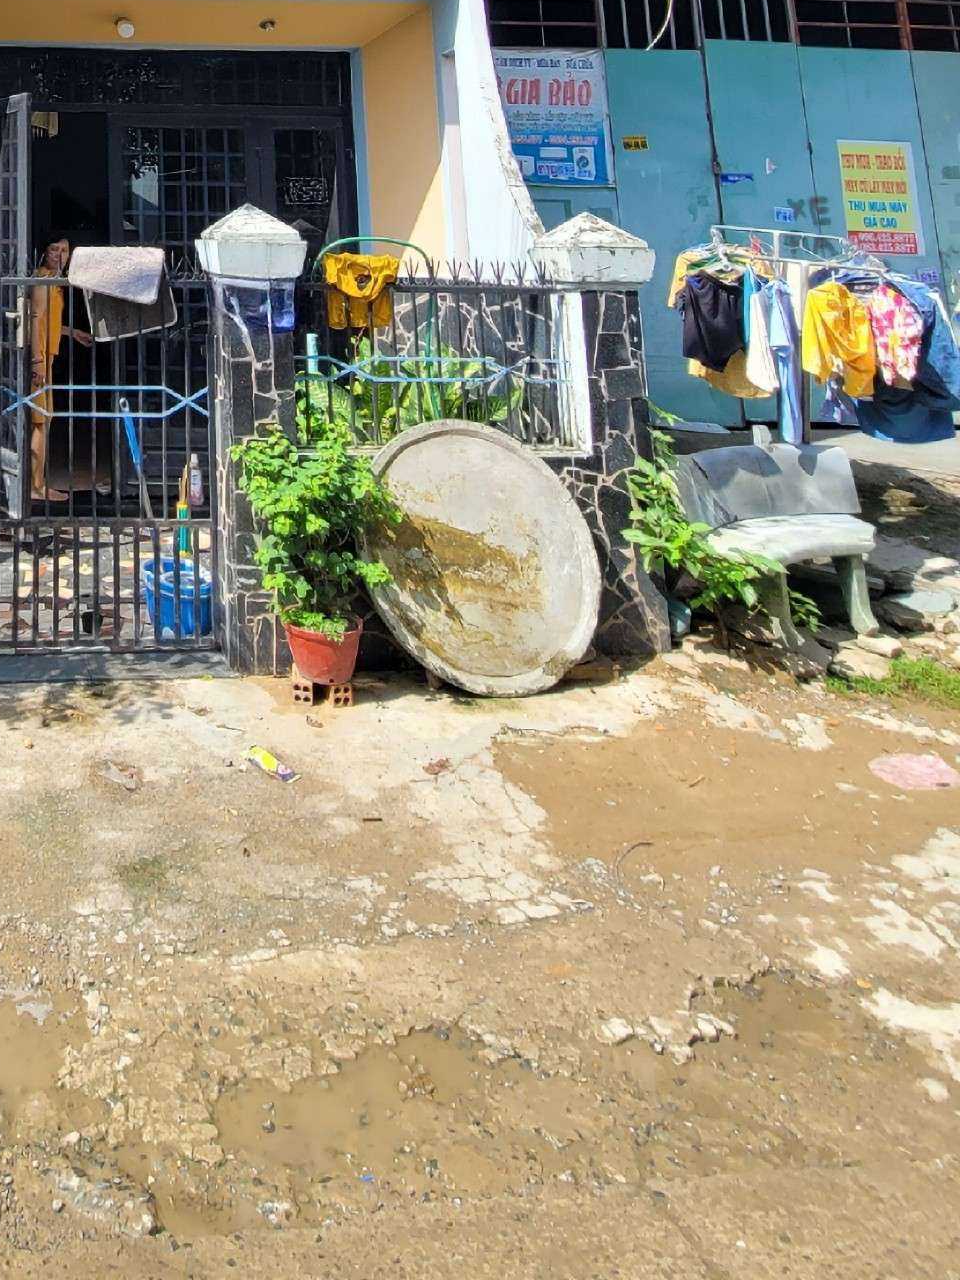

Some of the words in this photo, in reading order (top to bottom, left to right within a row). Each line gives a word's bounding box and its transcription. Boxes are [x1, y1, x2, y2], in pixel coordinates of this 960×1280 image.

[506, 78, 541, 105] GIA
[548, 72, 592, 106] BẢO
[848, 200, 865, 212] THU
[868, 201, 887, 213] MUA
[880, 217, 898, 228] CAO
